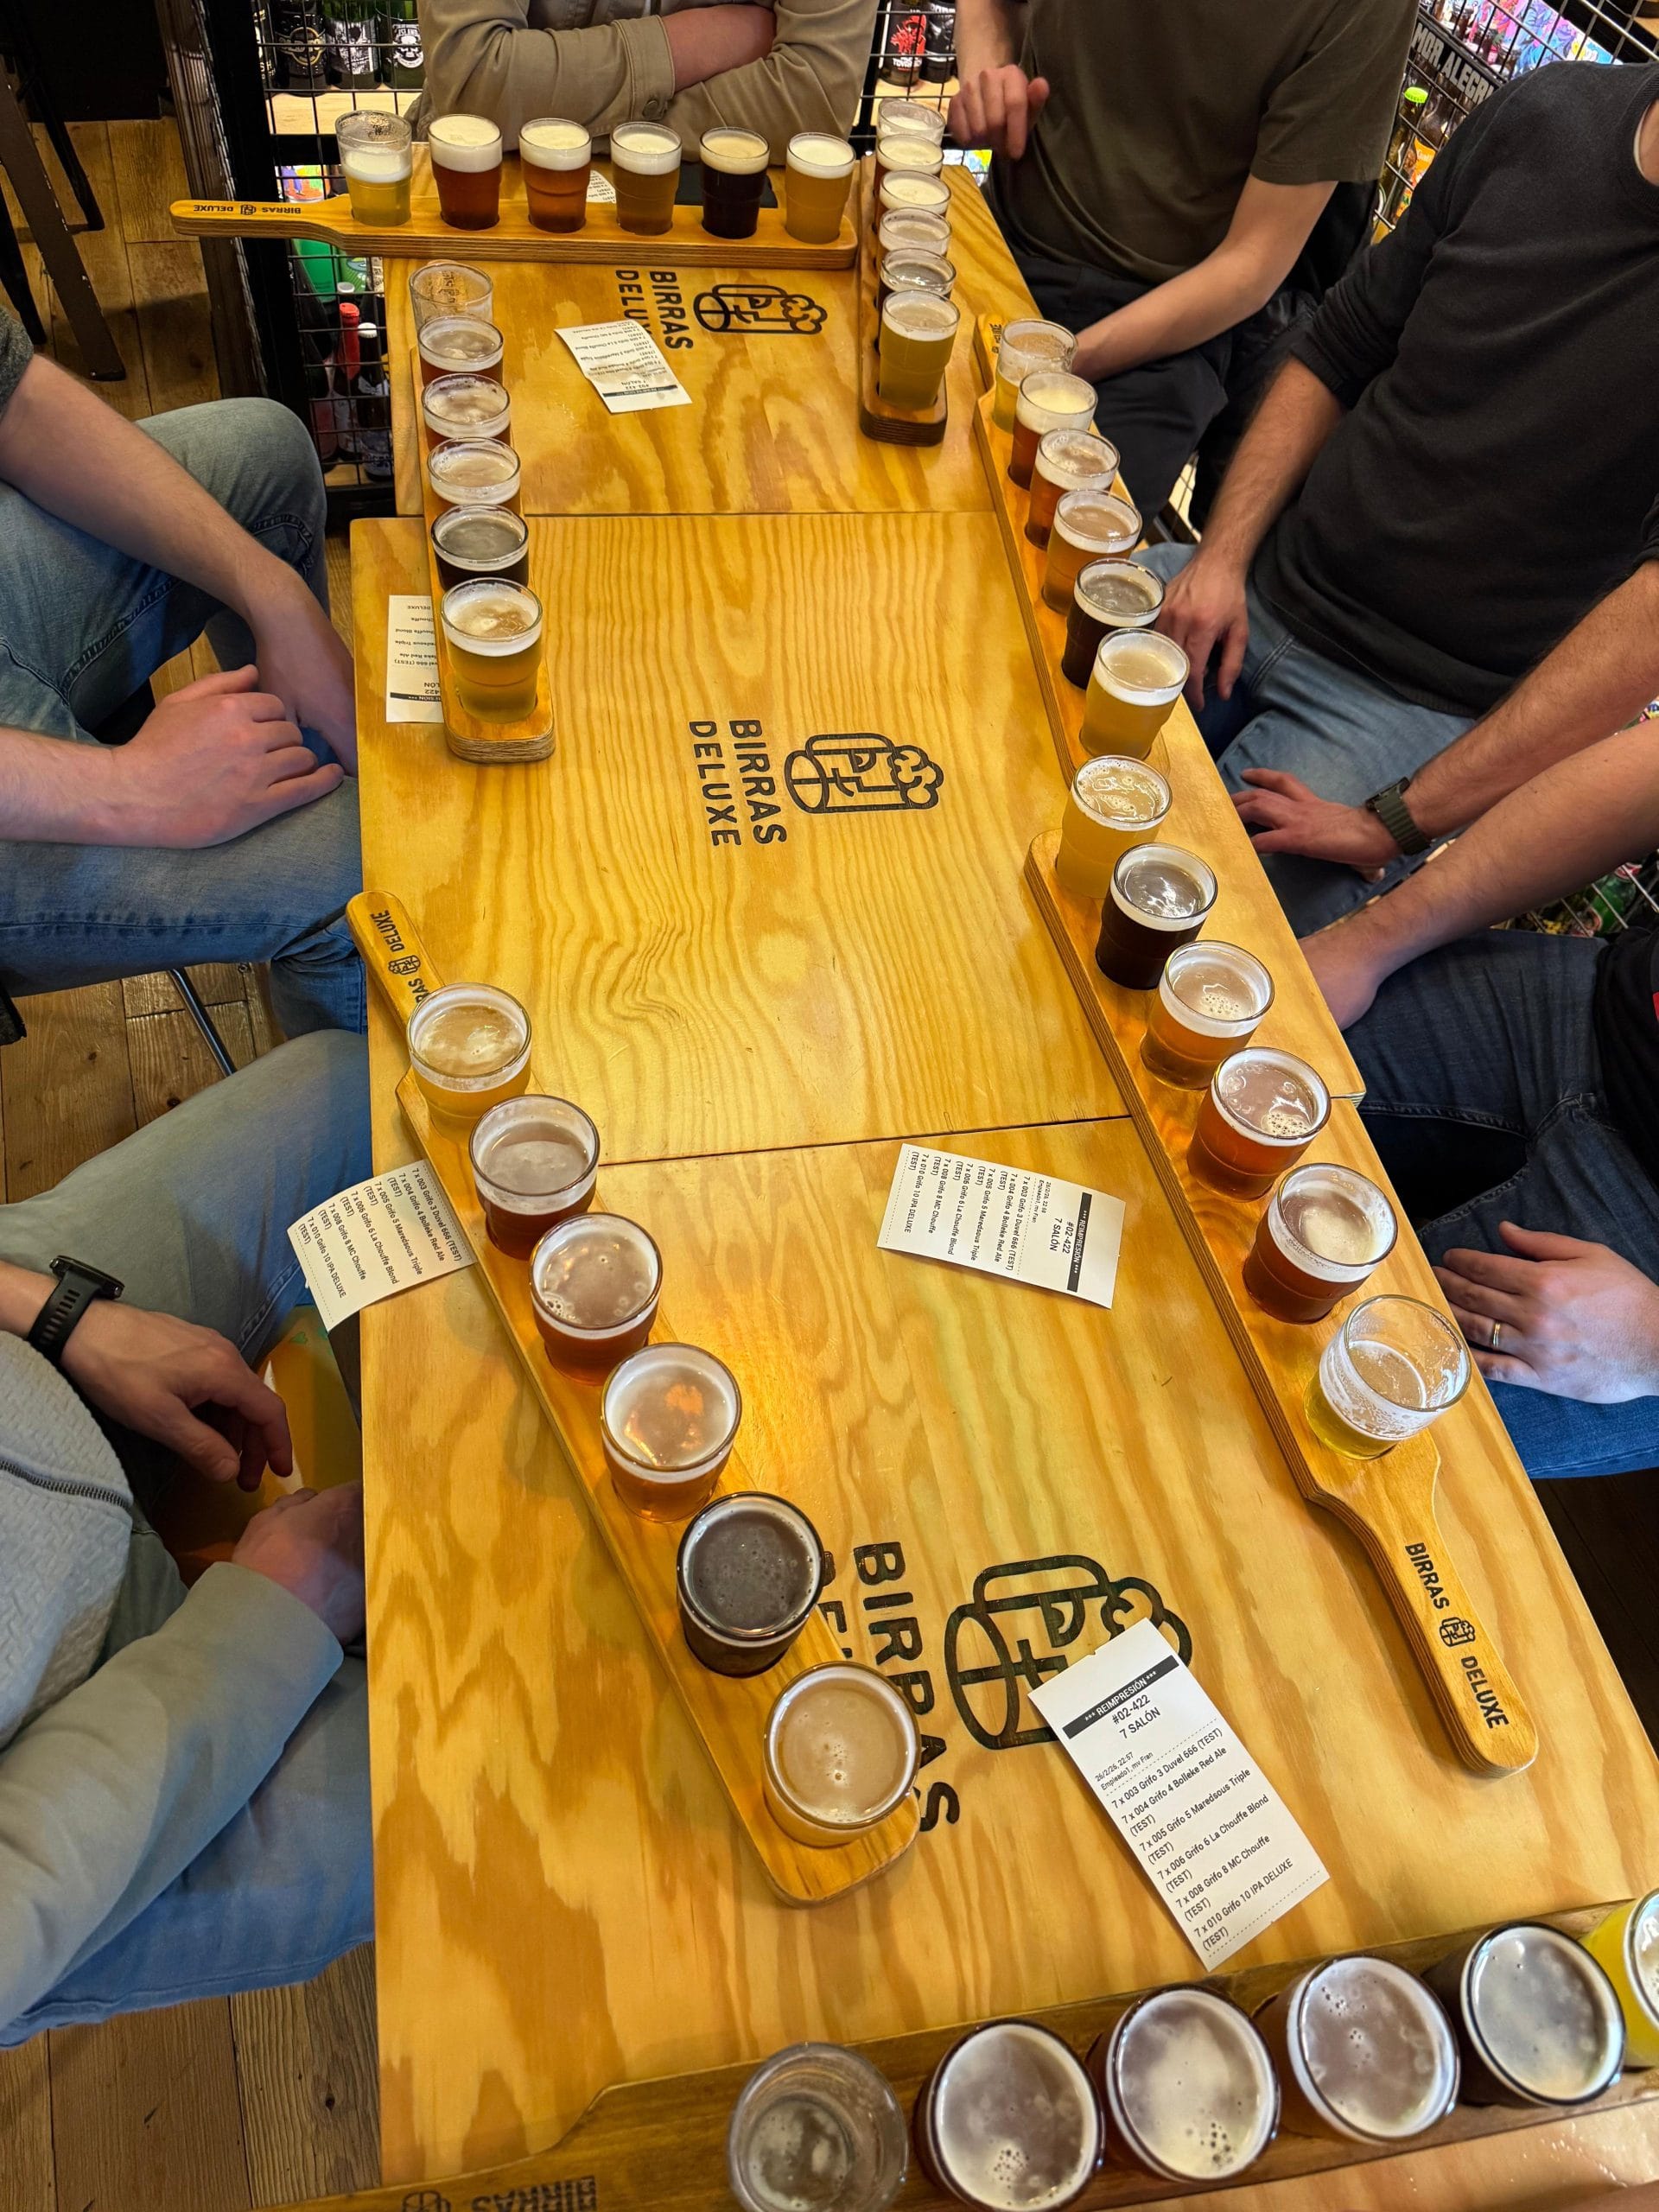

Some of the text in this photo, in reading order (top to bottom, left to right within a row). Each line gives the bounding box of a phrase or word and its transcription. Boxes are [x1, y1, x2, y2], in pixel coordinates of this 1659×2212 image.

[650, 270, 694, 349] BIRRAS
[689, 721, 741, 846] DELUXE
[728, 720, 787, 844] BIRRAS
[370, 909, 404, 952] DELUXE
[340, 1196, 354, 1217] (TEST)
[363, 1185, 378, 1205] (TEST)
[386, 1177, 403, 1197] (TEST)
[297, 1223, 311, 1244] (TEST)
[317, 1209, 332, 1230] (TEST)
[361, 1212, 372, 1228] Grifo
[370, 1232, 378, 1241] La
[374, 1241, 389, 1265] Chouffe
[385, 1265, 399, 1284] Blond
[378, 1191, 390, 1203] 005
[385, 1203, 396, 1218] Grifo
[394, 1223, 413, 1256] Maredsous
[410, 1256, 423, 1274] Triple
[403, 1182, 414, 1195] 004
[409, 1195, 420, 1210] Grifo
[429, 1237, 441, 1250] Red
[435, 1250, 444, 1261] Ale
[416, 1178, 427, 1190] 003
[423, 1190, 433, 1205] Grifo
[432, 1210, 446, 1228] Duvel
[446, 1240, 462, 1261] (TEST)
[311, 1226, 321, 1239] 010
[316, 1237, 326, 1254] Grifo
[322, 1252, 330, 1262] 10
[331, 1271, 346, 1298] DELUXE
[338, 1224, 347, 1239] Grifo
[346, 1243, 356, 1255] MC
[352, 1255, 365, 1280] Chouffe
[1405, 1541, 1509, 1729] BIRRAS DELUXE
[1096, 1677, 1147, 1715] REIMPRESIÓN
[1112, 1694, 1150, 1724] #02-422
[1119, 1707, 1160, 1738] 7 SALÓN
[1111, 1799, 1117, 1808] 7
[1123, 1785, 1139, 1800] 003
[1138, 1774, 1157, 1789] Grifo
[1162, 1753, 1184, 1773] Duvel
[1182, 1744, 1198, 1758] 666
[1197, 1727, 1222, 1749] (TEST)
[1121, 1815, 1128, 1823] 7
[1134, 1801, 1149, 1815] 004
[1148, 1789, 1167, 1804] Grifo
[1172, 1766, 1199, 1788] Bolleke
[1198, 1754, 1214, 1769] Red
[1214, 1747, 1226, 1759] Ale
[1129, 1814, 1155, 1837] (TEST)
[1139, 1842, 1146, 1851] 7
[1151, 1827, 1166, 1842] 005
[1166, 1816, 1185, 1832] Grifo
[1184, 1809, 1192, 1818] 5
[1190, 1783, 1230, 1815] Maredsous
[1228, 1769, 1250, 1786] Triple
[1157, 1870, 1163, 1879] 7
[1169, 1855, 1185, 1870] 006
[1185, 1843, 1204, 1859] Grifo
[1203, 1837, 1210, 1846] 6
[1208, 1831, 1220, 1841] La
[1219, 1810, 1248, 1834] Chouffe
[1246, 1794, 1268, 1814] Blond
[1147, 1840, 1173, 1865] (TEST)
[1166, 1868, 1192, 1893] (TEST)
[1175, 1898, 1182, 1907] 7
[1188, 1883, 1204, 1898] 008
[1203, 1872, 1222, 1887] Grifo
[1221, 1865, 1229, 1873] 8
[1227, 1855, 1241, 1869] MC
[1240, 1835, 1269, 1859] Chouffe
[1184, 1897, 1211, 1922] (TEST)
[1193, 1858, 1293, 1937] 7 x 010 Grifo 10 IPA DELUXE
[1202, 1926, 1228, 1951] (TEST)
